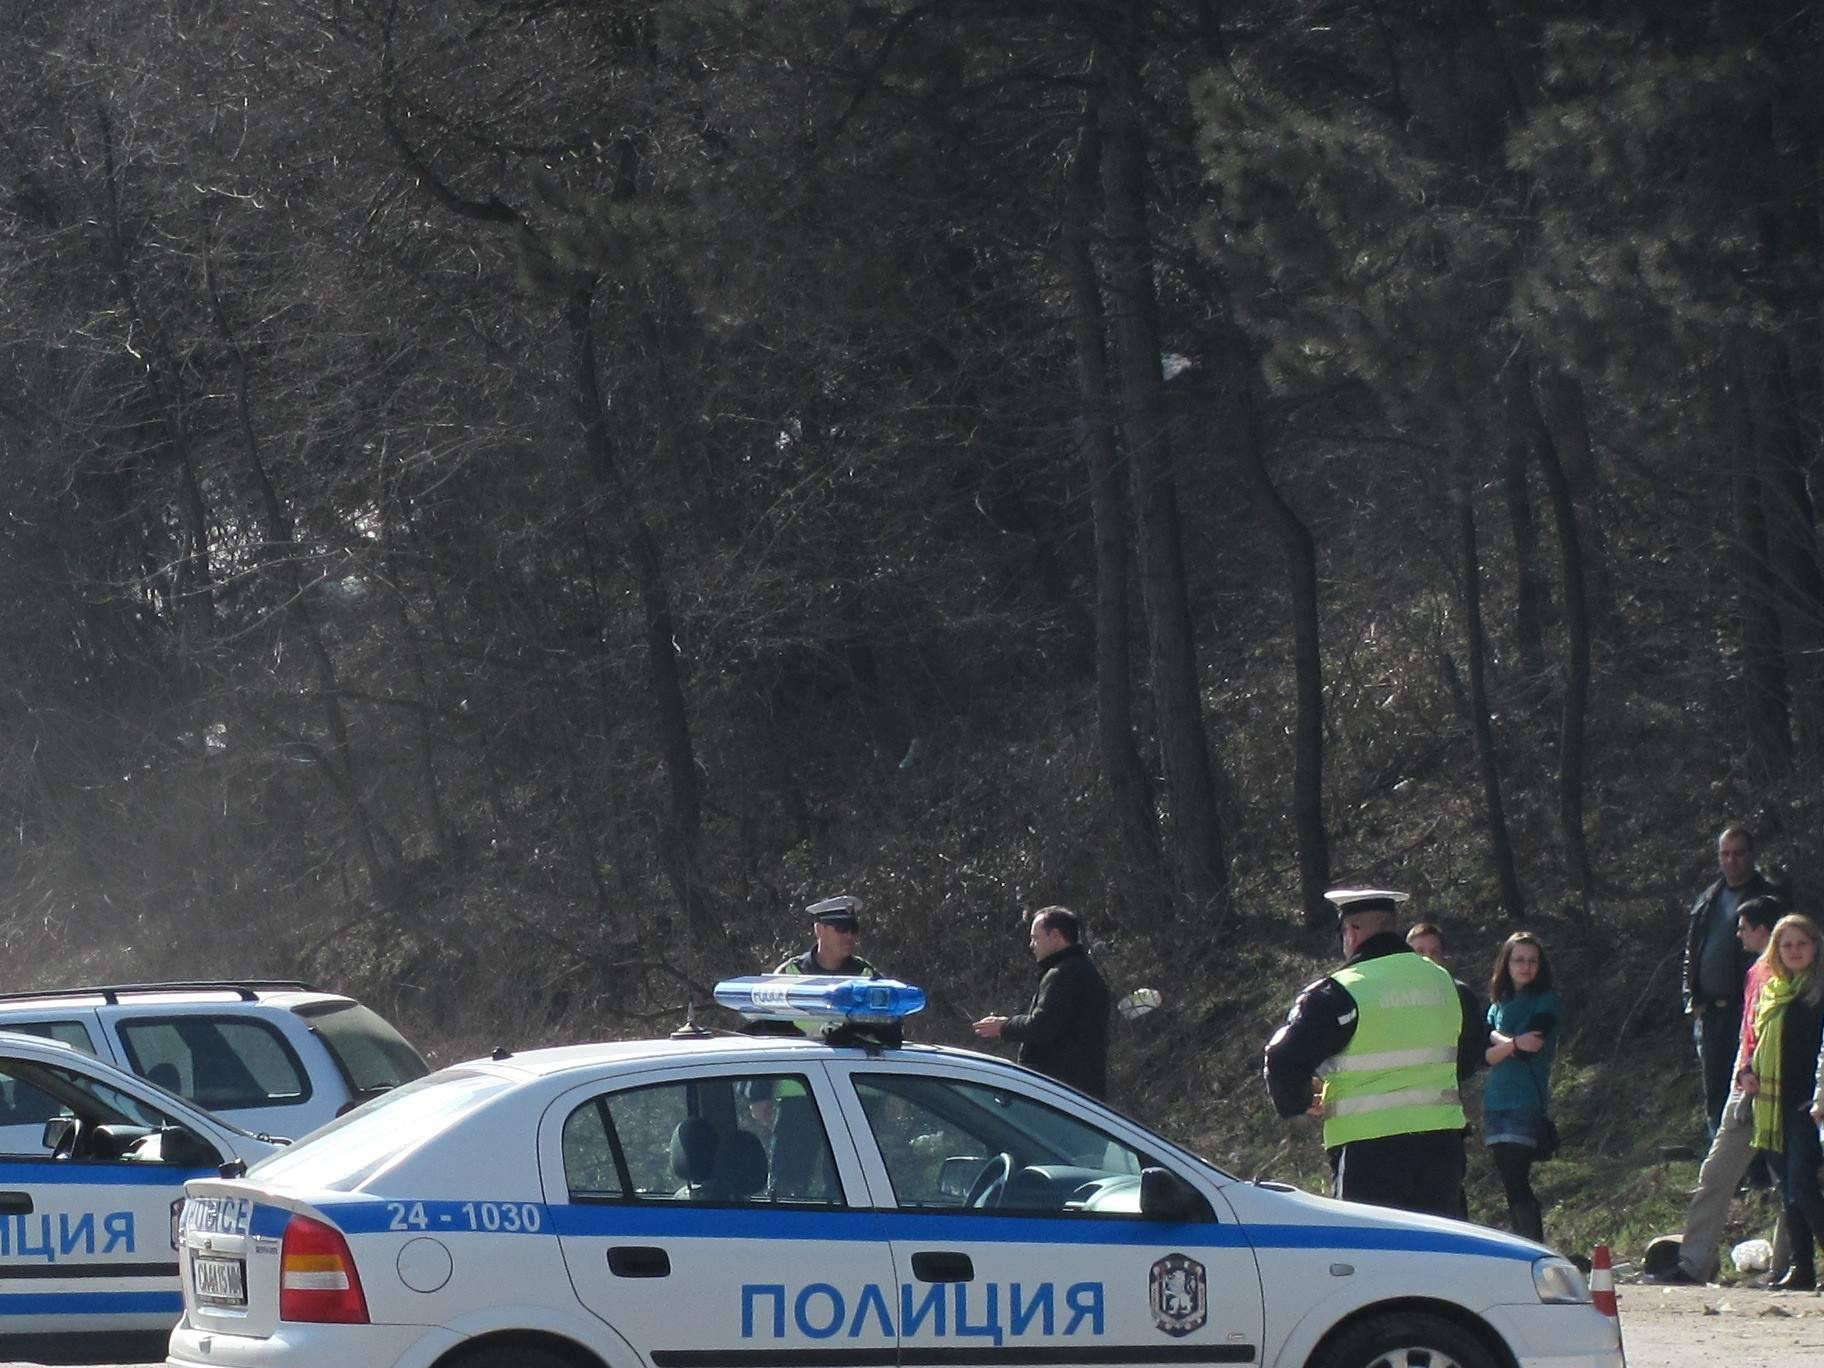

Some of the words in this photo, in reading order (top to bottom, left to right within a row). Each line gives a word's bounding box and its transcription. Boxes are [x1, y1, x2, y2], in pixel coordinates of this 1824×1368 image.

[387, 1202, 429, 1230] 24
[462, 1202, 541, 1232] 1030
[741, 1282, 1104, 1346] ПОЛИЦИЯ
